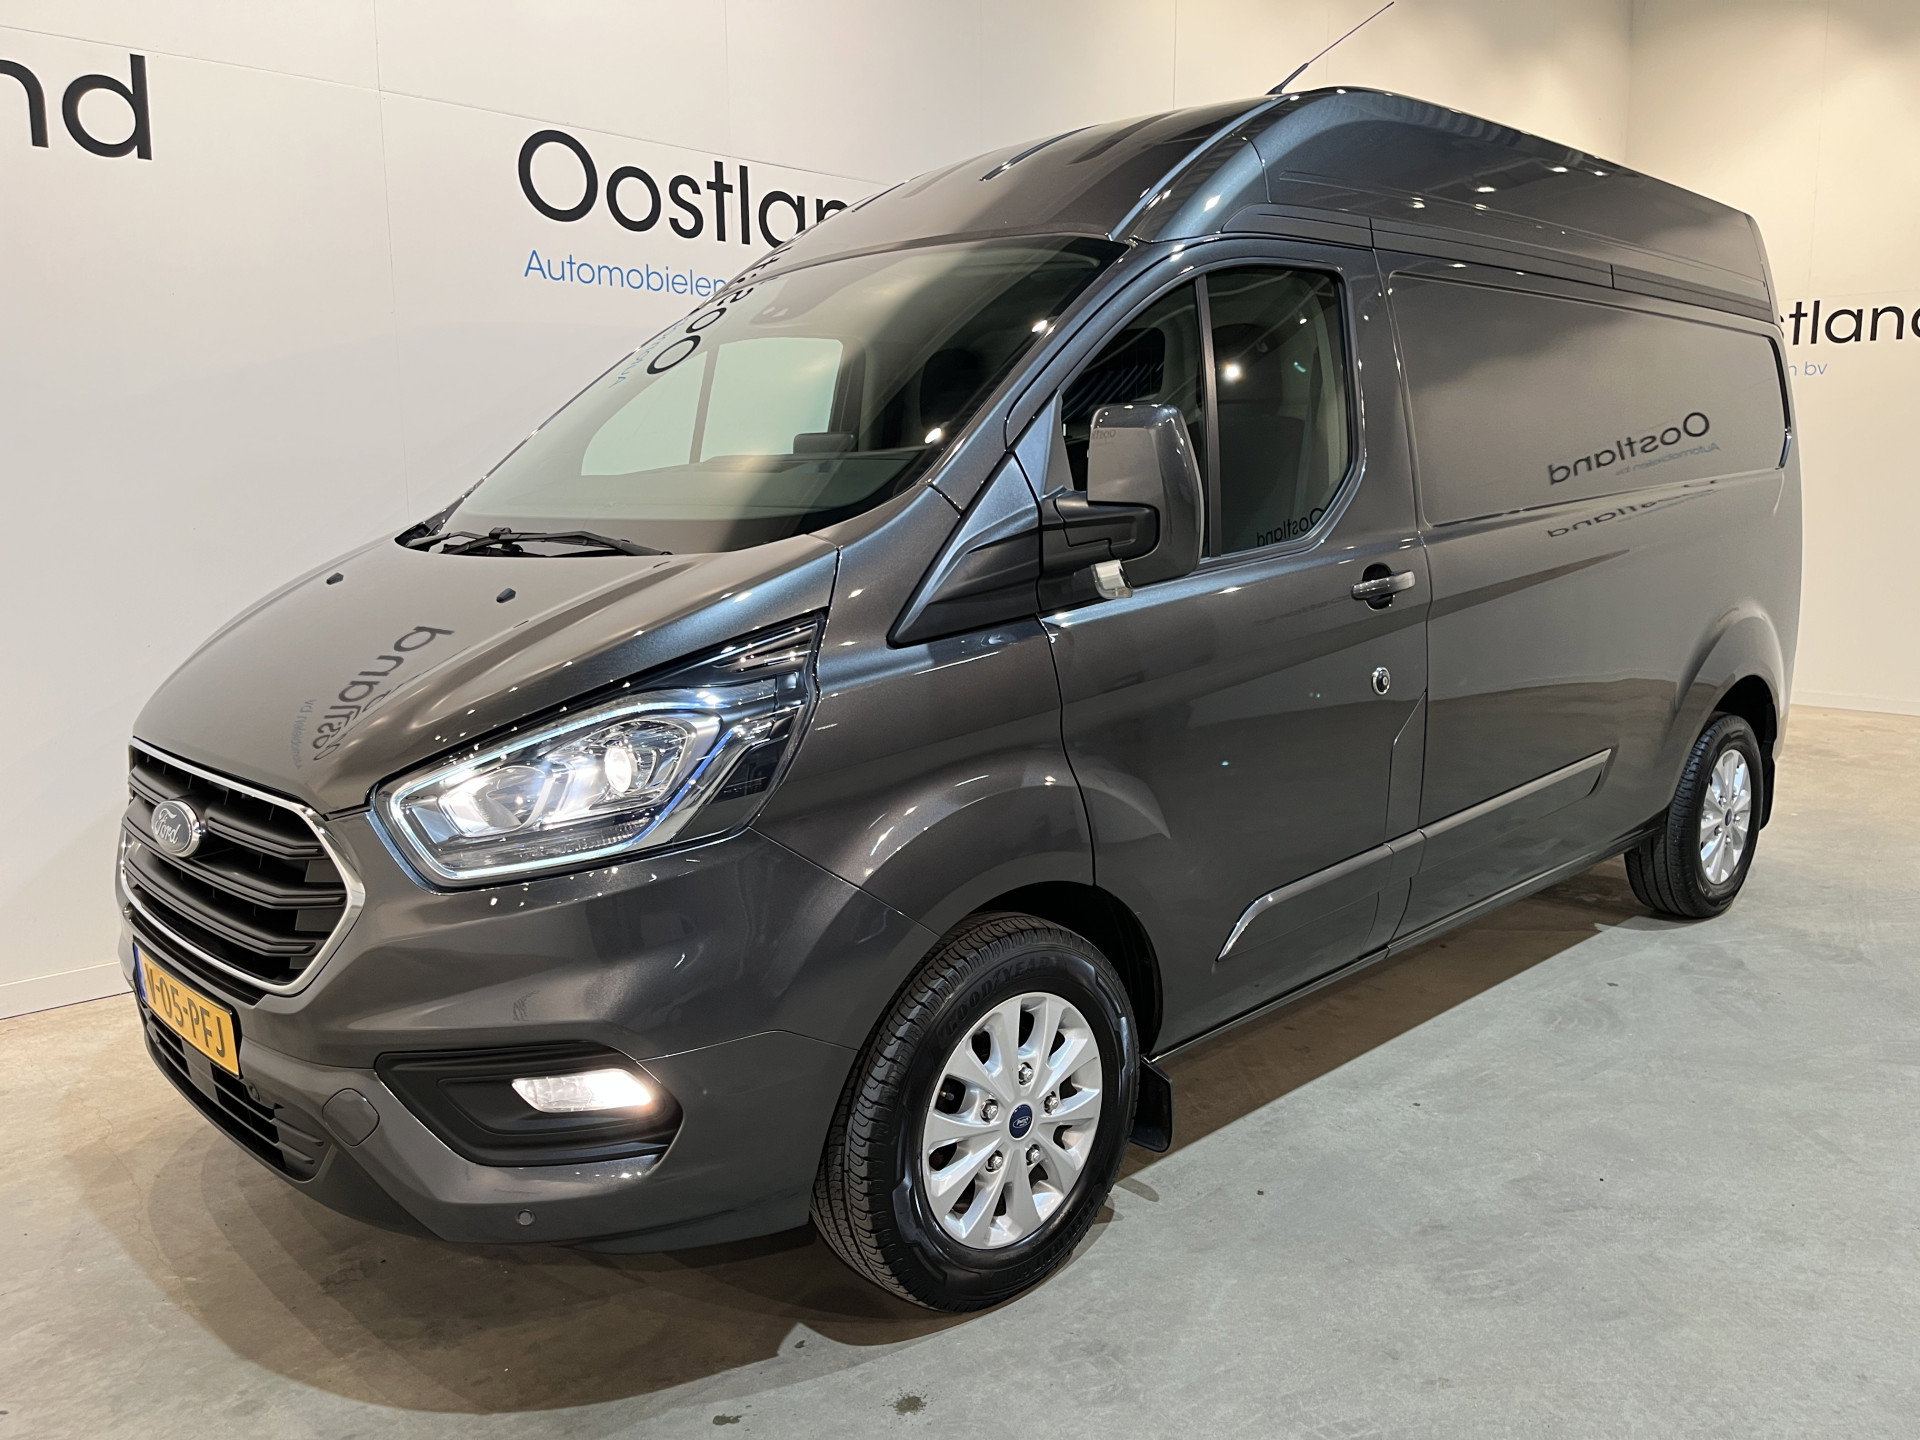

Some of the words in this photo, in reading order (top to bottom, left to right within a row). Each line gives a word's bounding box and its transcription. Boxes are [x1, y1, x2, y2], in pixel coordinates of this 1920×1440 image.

[1780, 300, 1920, 346] tlan
[1804, 361, 1828, 376] bv
[153, 807, 182, 845] Ford
[144, 962, 227, 1059] V-05-PFJ
